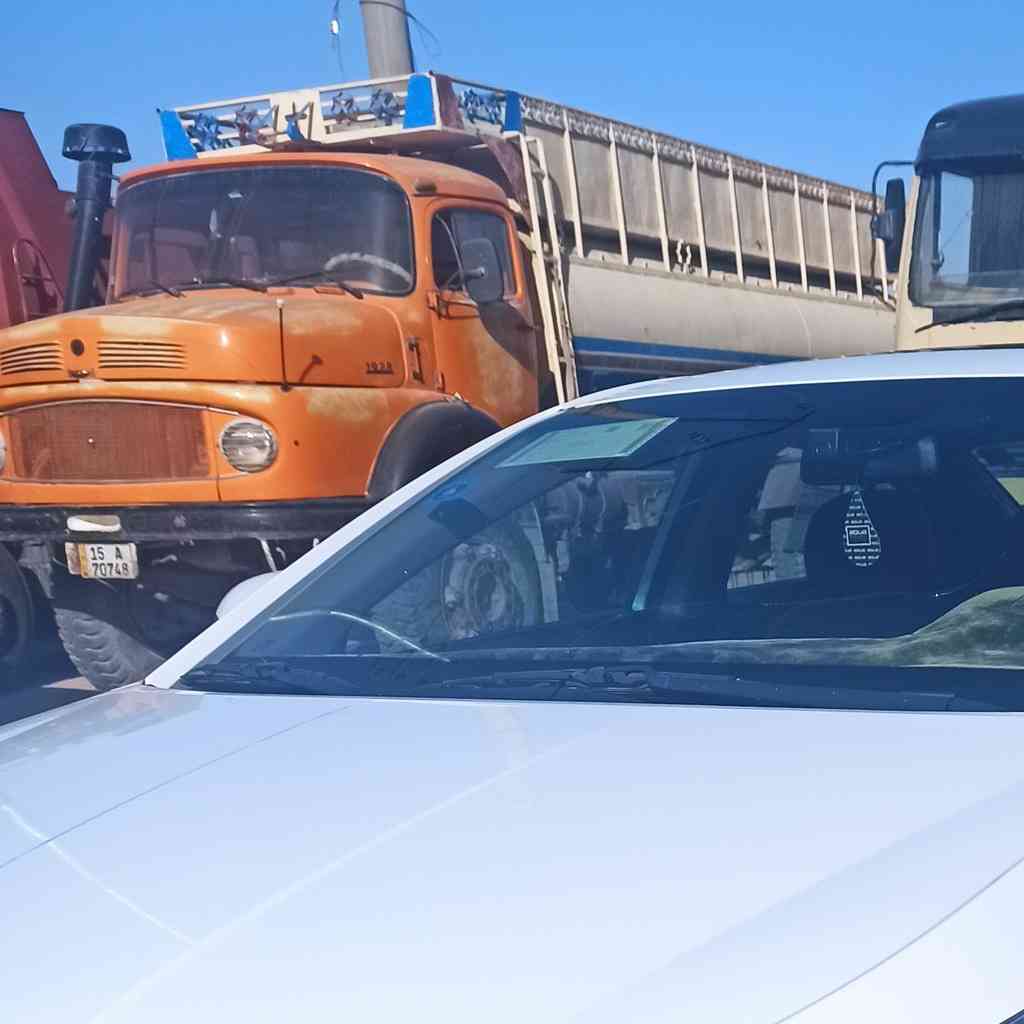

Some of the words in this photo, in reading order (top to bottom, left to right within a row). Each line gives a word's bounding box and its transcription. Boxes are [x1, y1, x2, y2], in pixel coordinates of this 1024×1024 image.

[90, 546, 105, 561] 15
[115, 546, 123, 560] A
[91, 562, 129, 577] 70748
